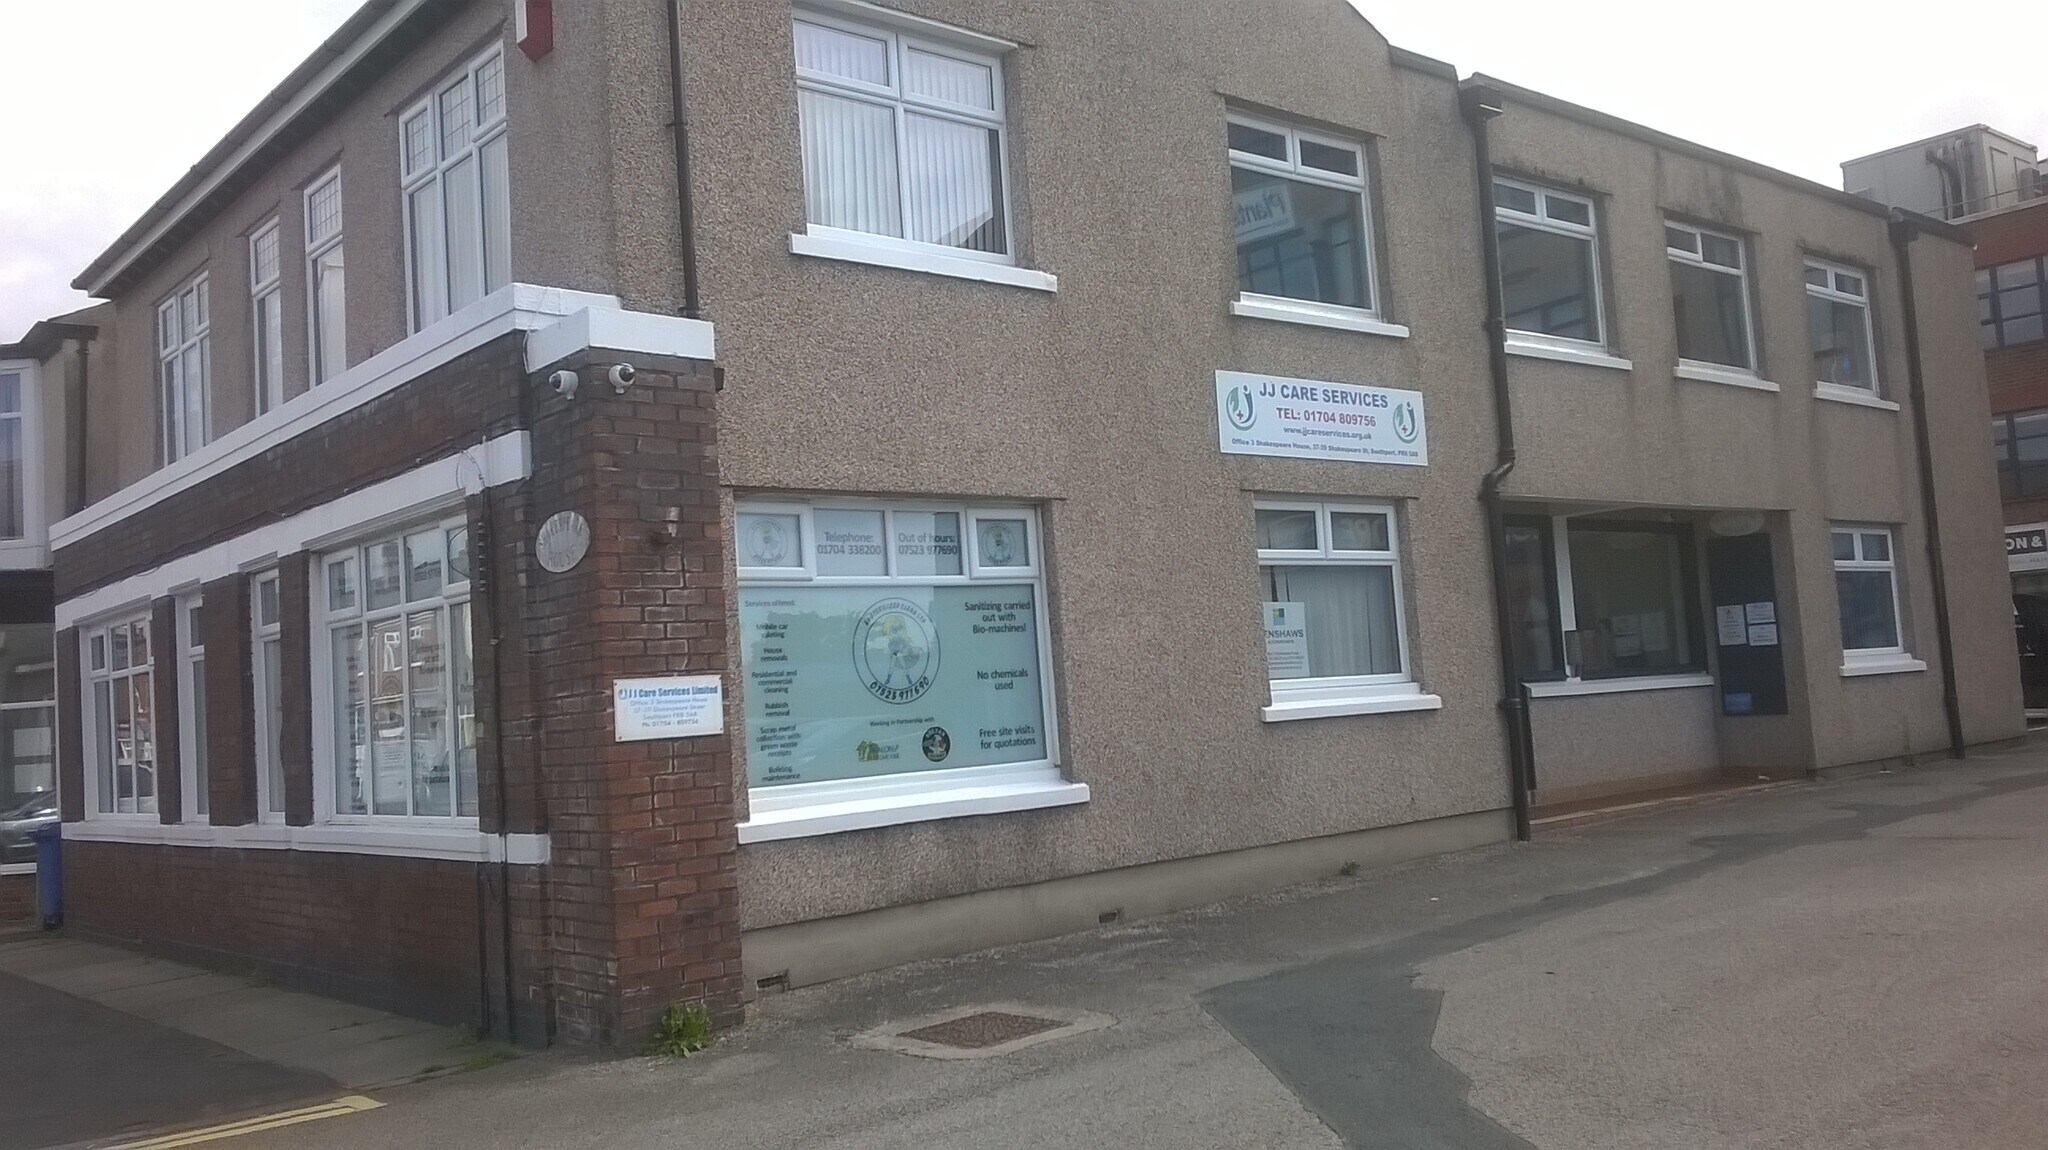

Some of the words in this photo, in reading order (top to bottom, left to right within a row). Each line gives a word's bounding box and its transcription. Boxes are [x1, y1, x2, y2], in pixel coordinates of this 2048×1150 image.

[1259, 382, 1276, 398] JJ
[1280, 384, 1319, 402] CARE
[1322, 388, 1389, 409] SERVICES
[1276, 407, 1301, 421] TEL:
[1303, 409, 1336, 424] 01704
[1339, 412, 1377, 427] 809756
[1283, 426, 1372, 441] www.jjcareservices.org.uk
[824, 531, 874, 544] Telephone:
[898, 532, 915, 543] Out
[917, 532, 926, 543] of
[928, 532, 956, 543] hours:
[2031, 535, 2044, 547] &
[817, 544, 845, 554] 01704
[847, 544, 881, 555] 338200
[898, 545, 925, 555] 07523
[926, 545, 958, 555] 977690
[964, 601, 1002, 612] Sanitizing
[1003, 600, 1031, 610] carried
[982, 614, 996, 622] out
[998, 612, 1016, 622] with
[972, 623, 1027, 634] Bio-machines!
[977, 670, 989, 680] No
[990, 667, 1029, 679] chemicals
[639, 689, 657, 698] Care
[658, 687, 690, 697] Services
[692, 685, 718, 695] Limited
[869, 681, 897, 700] 07523
[898, 676, 930, 700] 977690
[994, 680, 1014, 690] used
[979, 728, 997, 738] Free
[999, 726, 1014, 736] site
[1014, 724, 1036, 735] visits
[980, 739, 992, 750] for
[994, 736, 1037, 750] quotations
